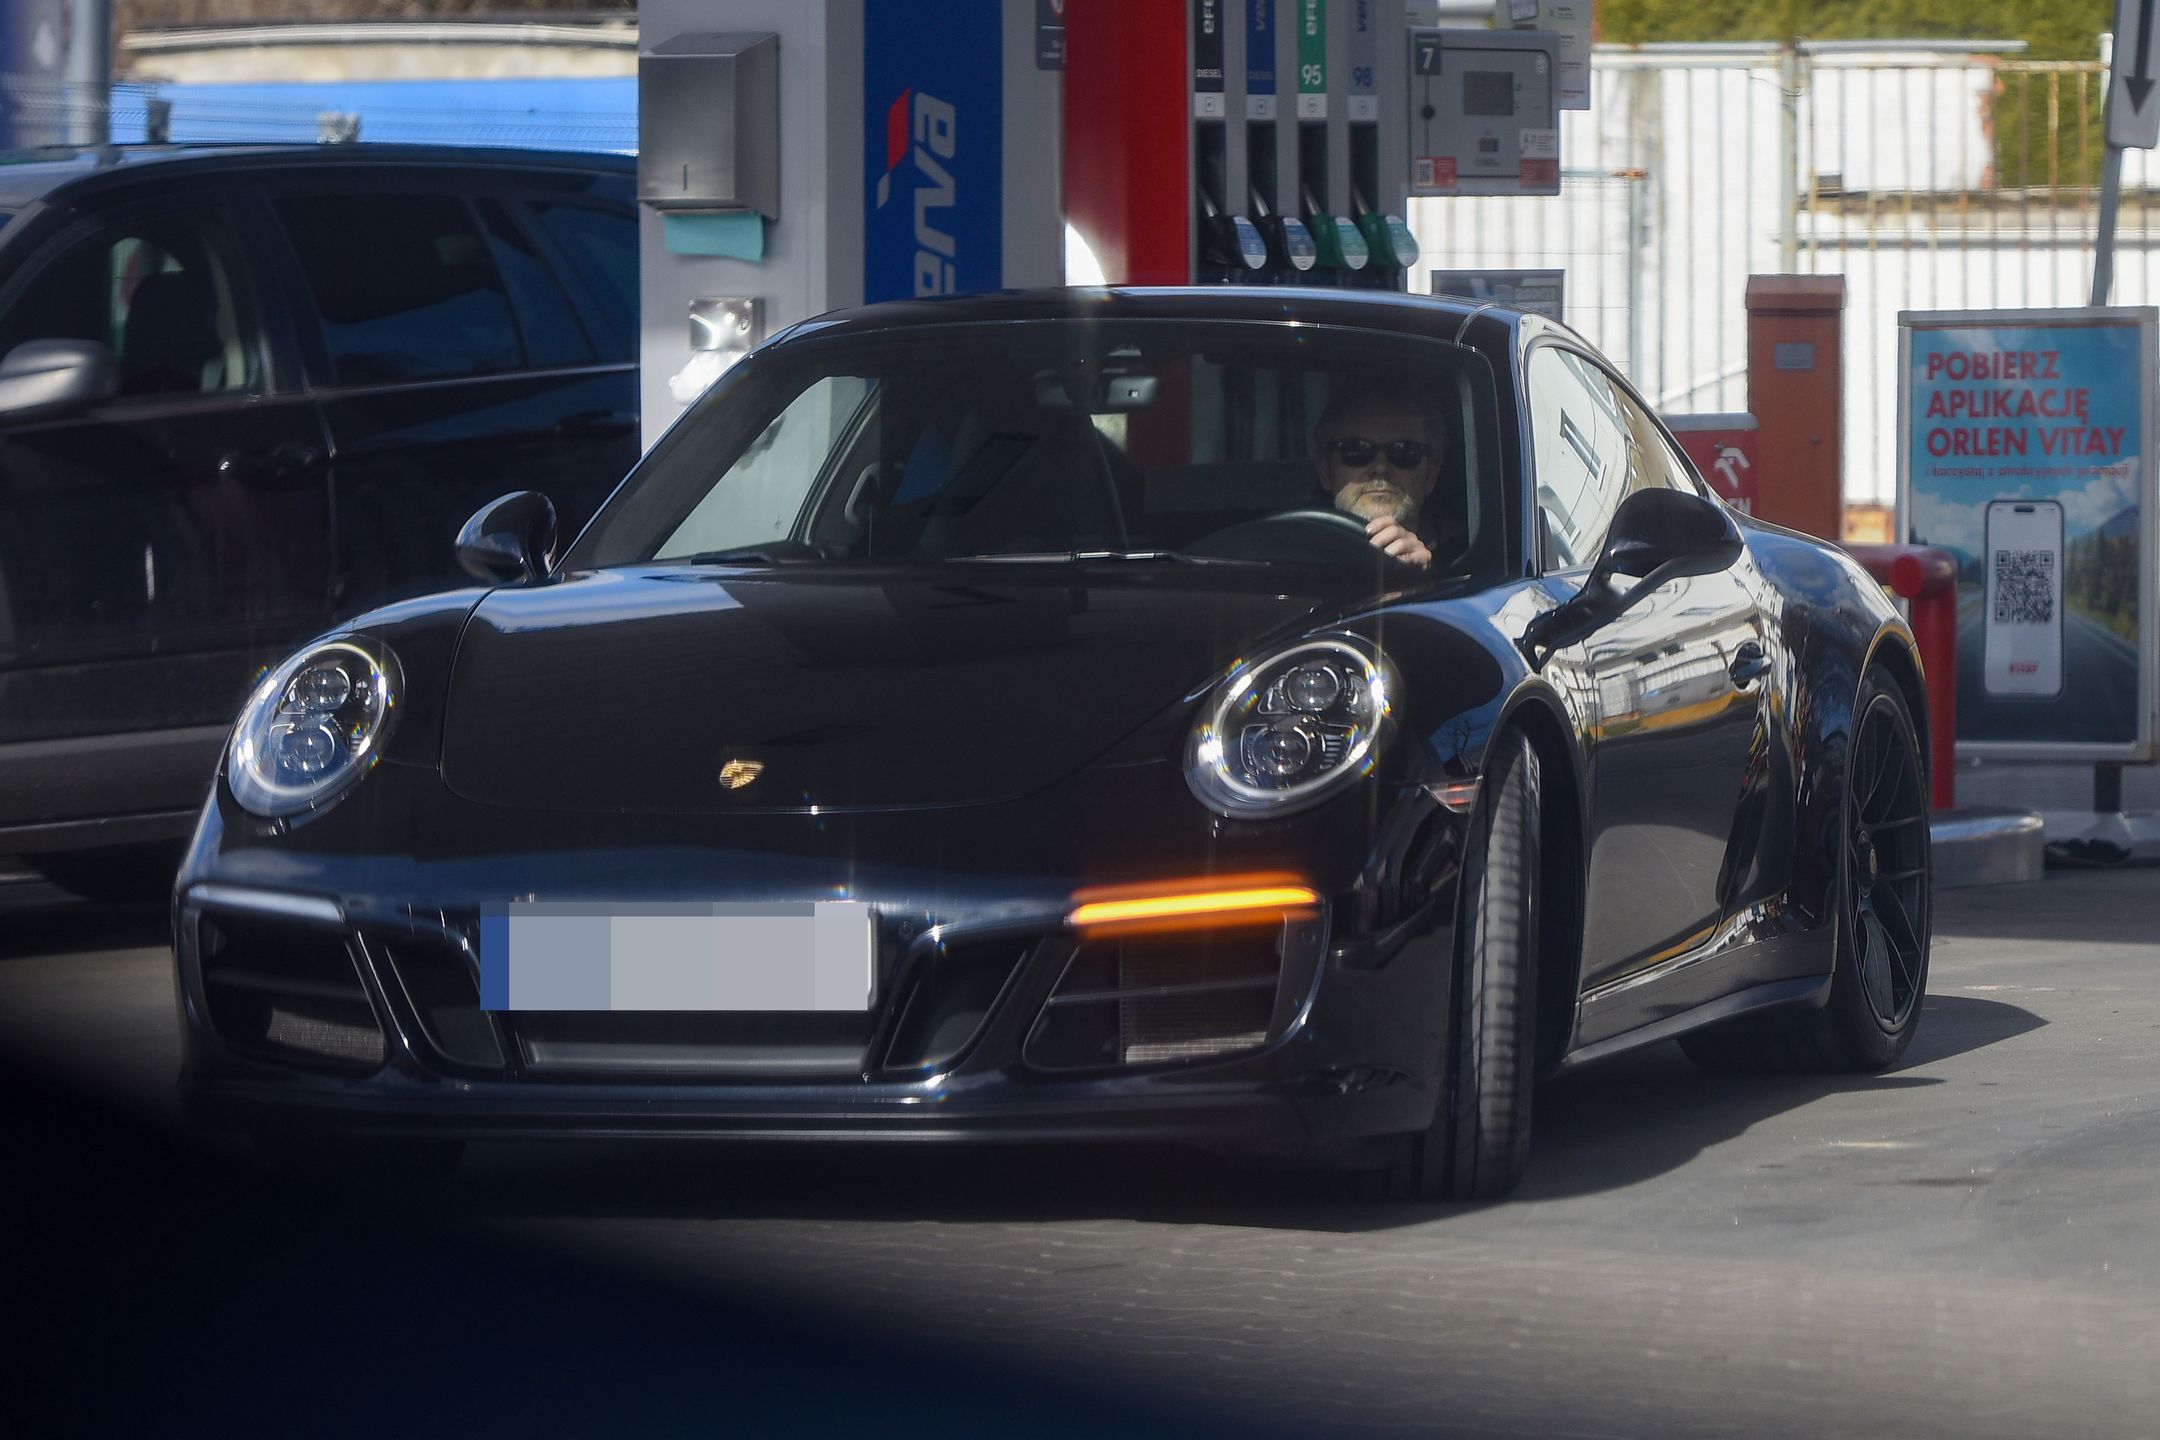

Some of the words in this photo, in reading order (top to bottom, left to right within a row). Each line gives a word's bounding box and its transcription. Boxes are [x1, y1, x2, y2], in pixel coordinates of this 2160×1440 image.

[1423, 47, 1435, 69] 7
[1196, 68, 1222, 79] DIESEL
[1302, 64, 1322, 86] 95
[1353, 67, 1373, 87] 98
[914, 91, 956, 298] erva
[1927, 351, 2060, 380] POBIERZ
[1926, 388, 2090, 425] APLIKACJĘ
[1926, 426, 2028, 457] ORLEN
[2038, 426, 2126, 456] VITAY
